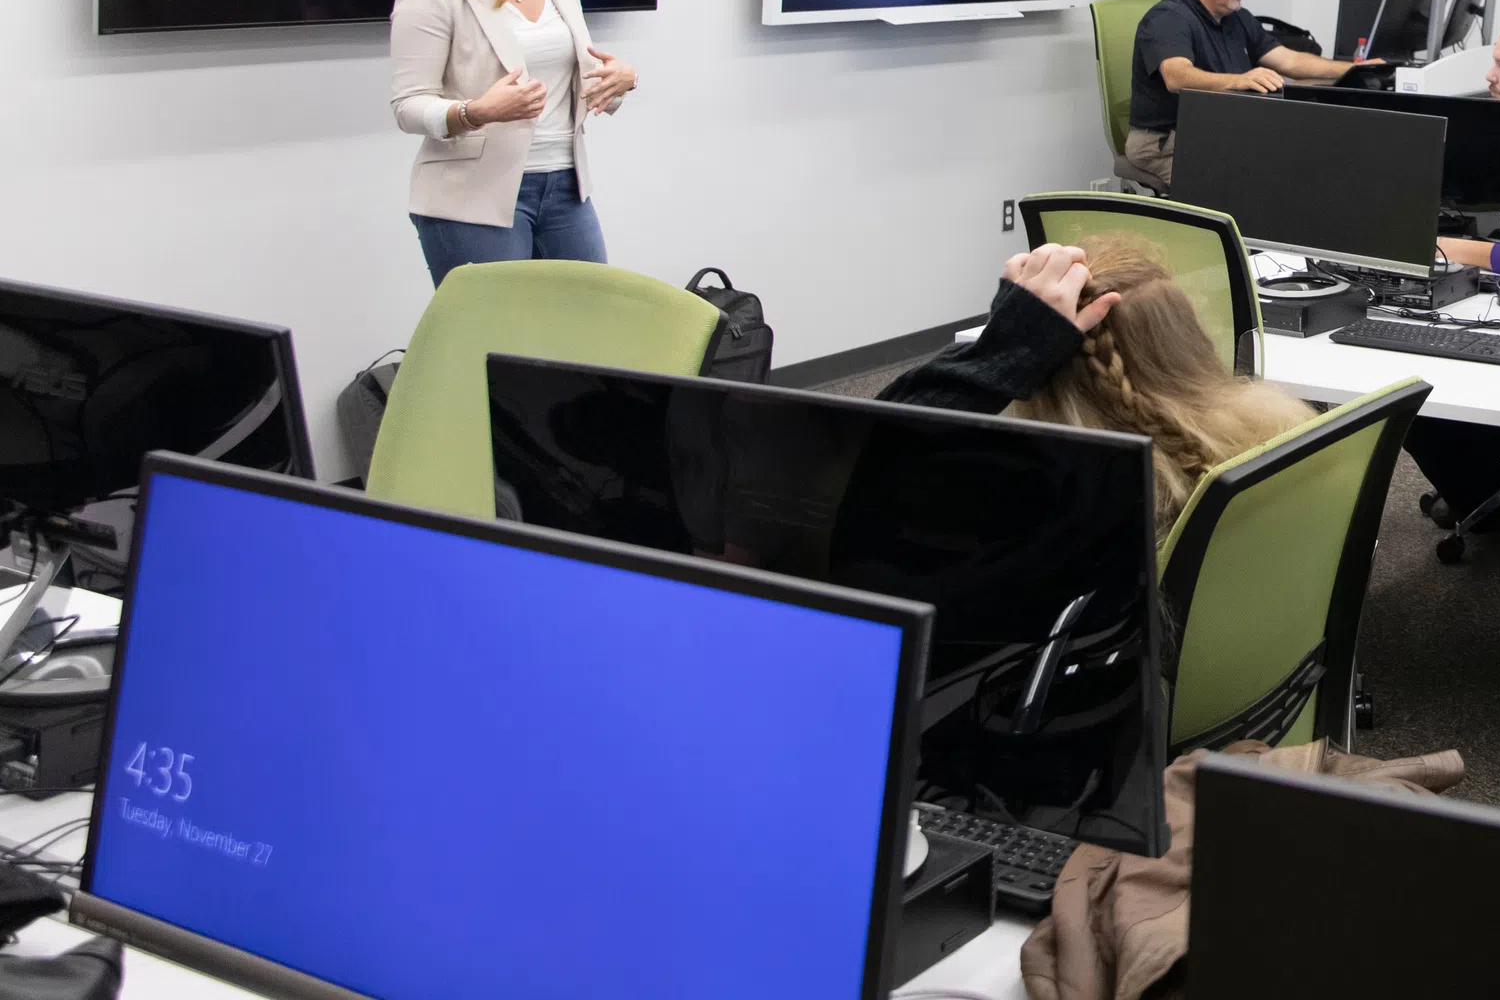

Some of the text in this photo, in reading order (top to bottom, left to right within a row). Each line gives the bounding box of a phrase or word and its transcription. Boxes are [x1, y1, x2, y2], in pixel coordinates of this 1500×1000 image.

[124, 741, 196, 802] 4:35
[120, 797, 273, 866] Tuesday, November 27
